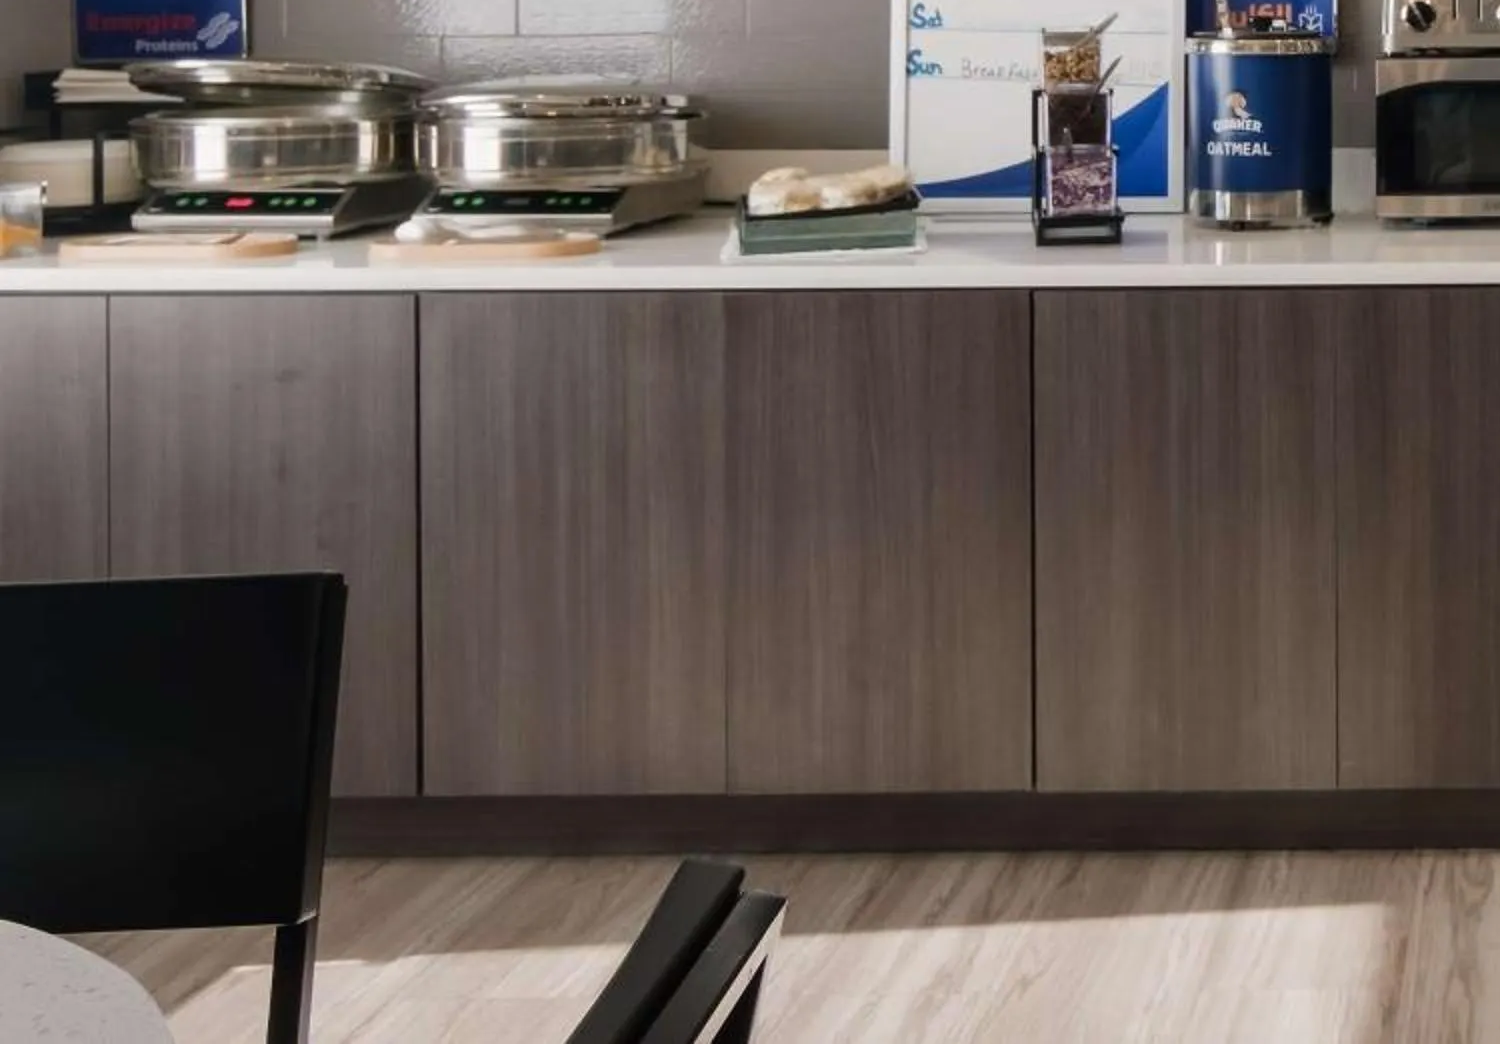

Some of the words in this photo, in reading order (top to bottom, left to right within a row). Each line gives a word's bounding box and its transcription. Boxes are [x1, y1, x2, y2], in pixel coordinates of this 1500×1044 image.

[910, 2, 943, 29] Sat
[135, 38, 199, 53] Proteins
[906, 48, 943, 76] Sun
[1212, 118, 1263, 133] QUAKER
[1207, 141, 1272, 157] OATMEAL
